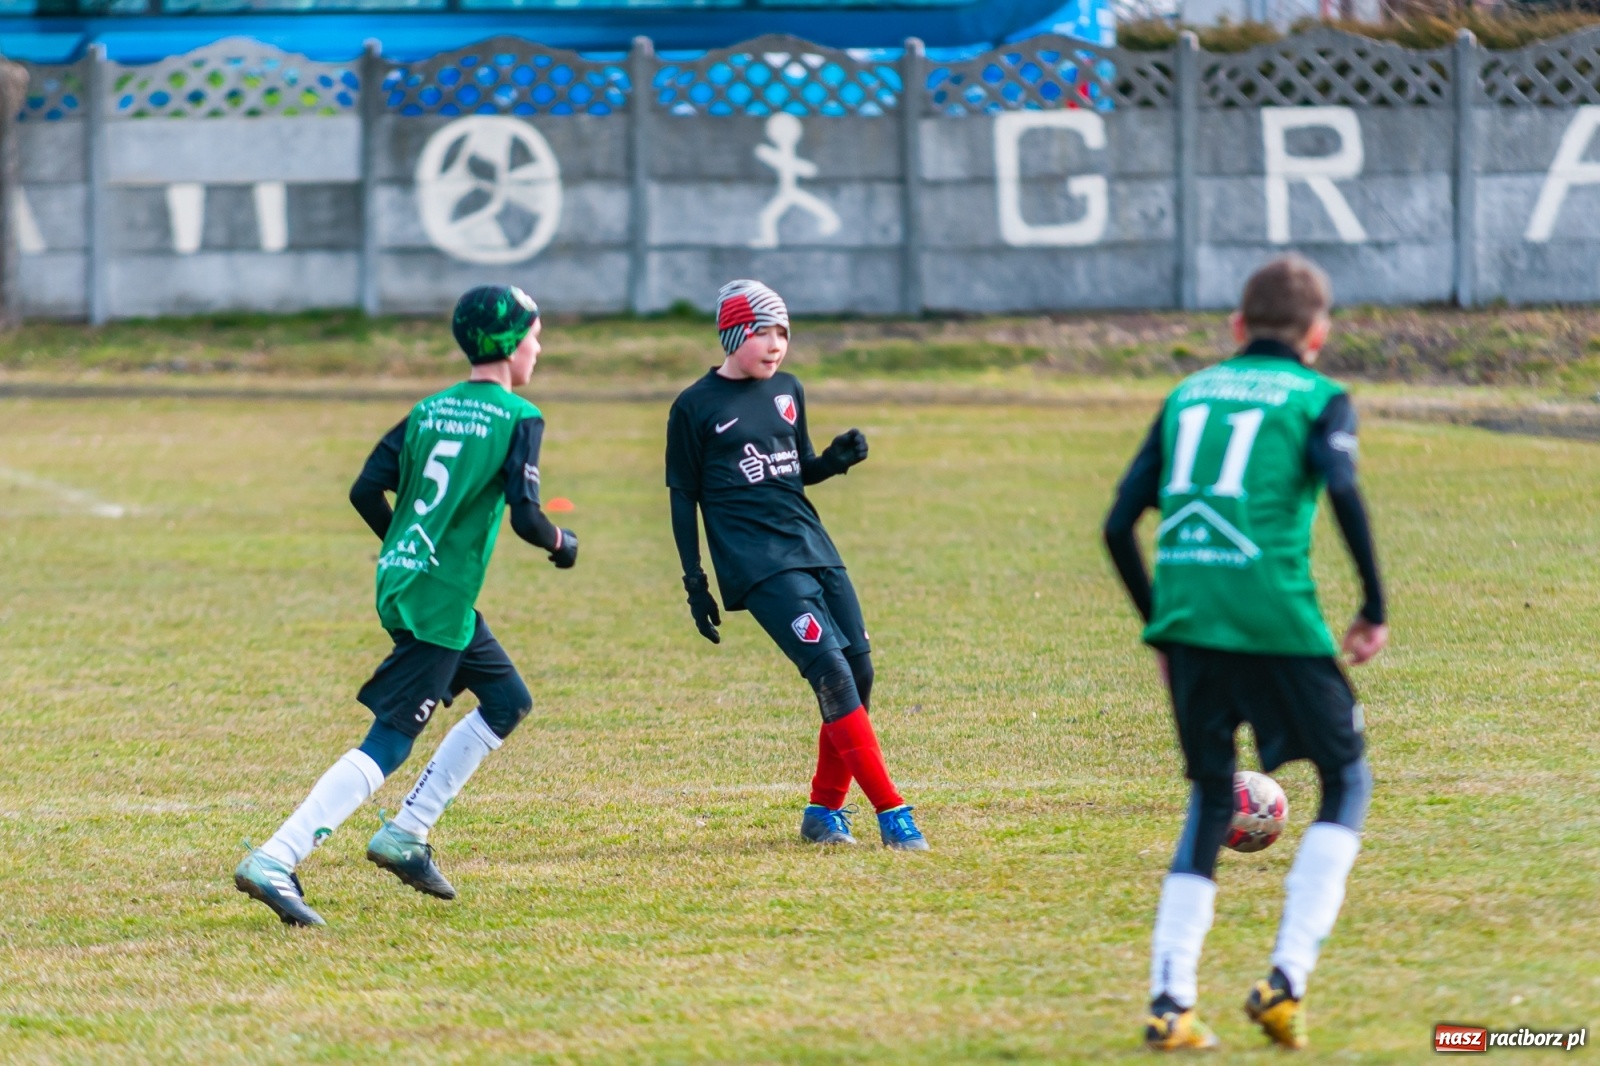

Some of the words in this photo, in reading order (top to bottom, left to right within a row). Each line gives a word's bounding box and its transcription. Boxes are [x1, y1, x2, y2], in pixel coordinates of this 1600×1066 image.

[413, 439, 463, 516] 5
[1161, 402, 1265, 501] 11
[414, 698, 436, 723] 5
